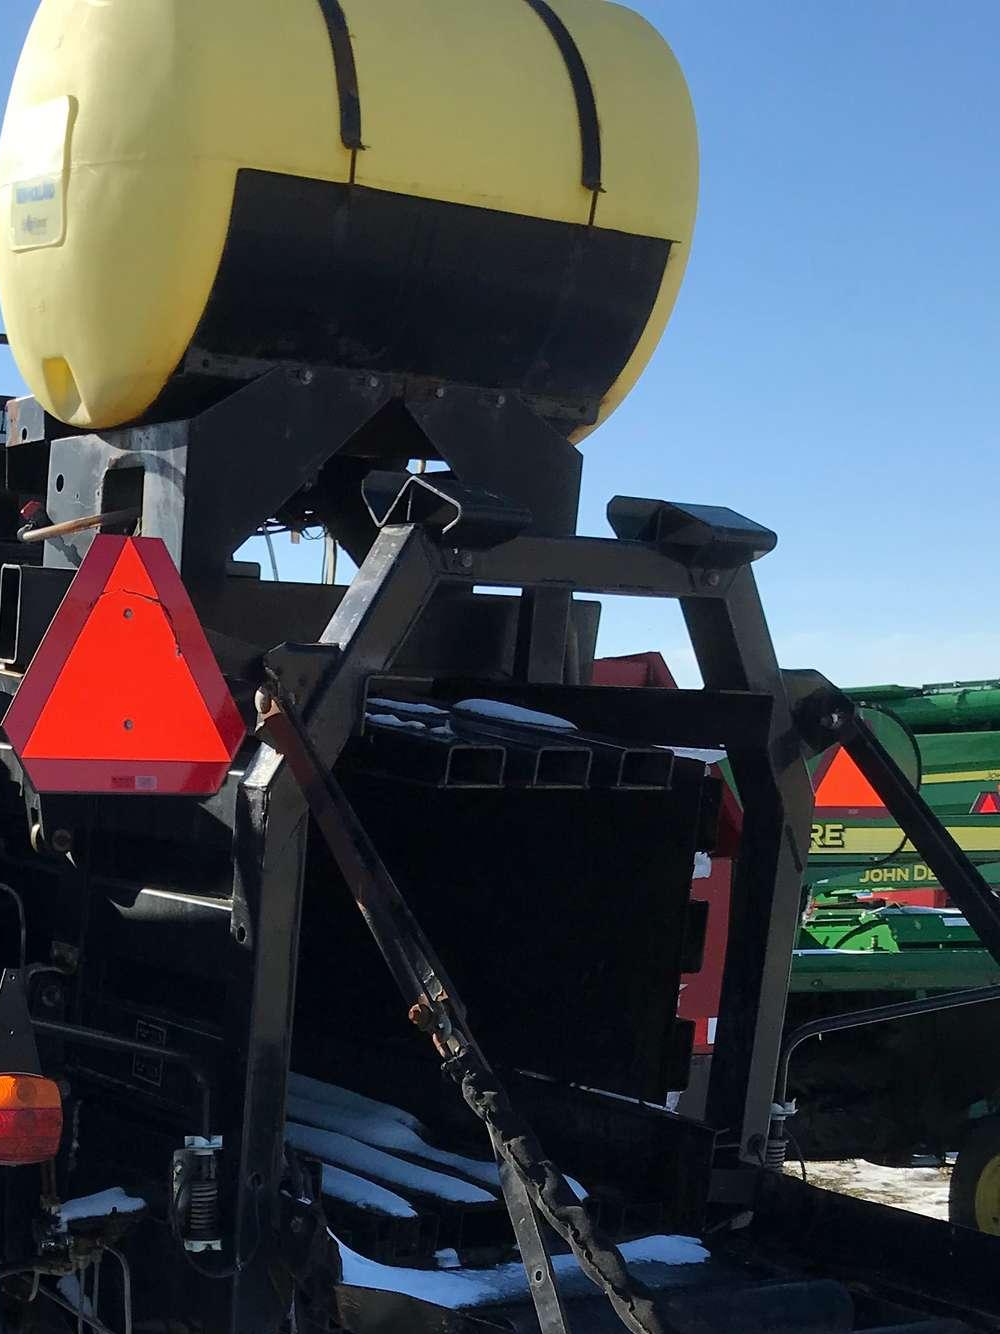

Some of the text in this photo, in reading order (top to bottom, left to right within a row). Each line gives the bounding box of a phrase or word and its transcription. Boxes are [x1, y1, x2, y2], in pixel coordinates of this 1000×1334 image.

[810, 824, 845, 847] RE
[859, 865, 937, 884] JOHN DE
